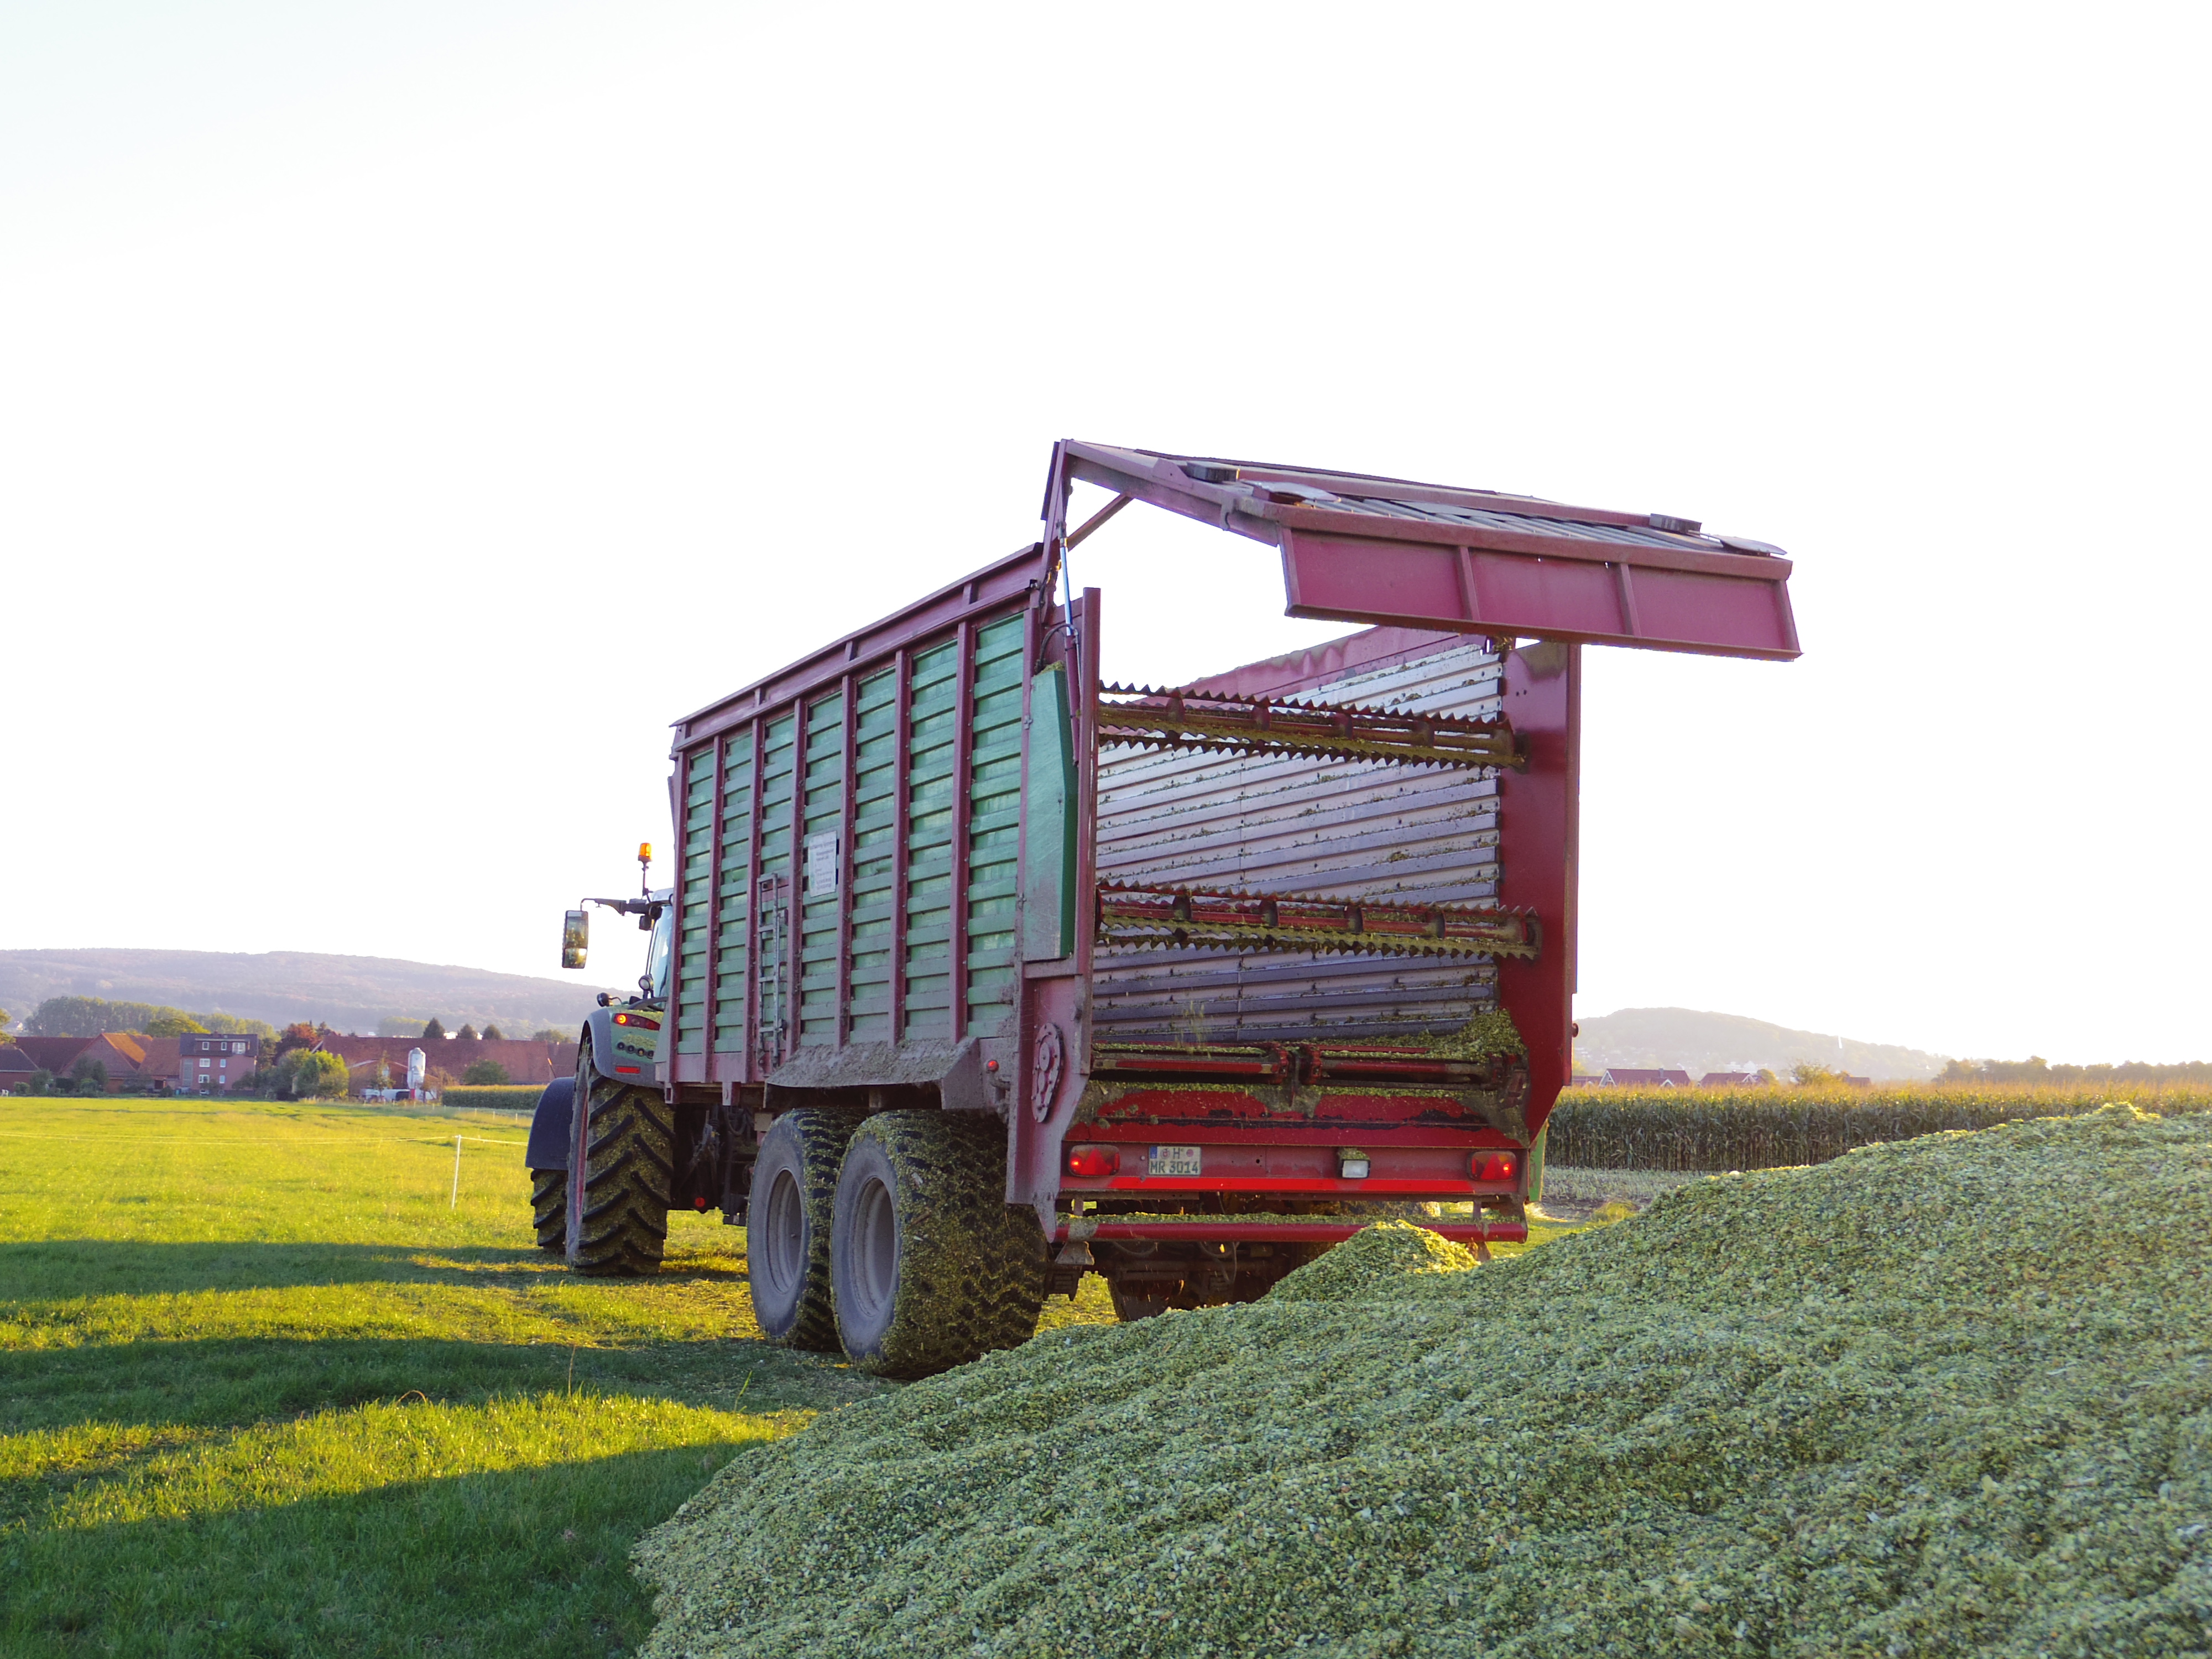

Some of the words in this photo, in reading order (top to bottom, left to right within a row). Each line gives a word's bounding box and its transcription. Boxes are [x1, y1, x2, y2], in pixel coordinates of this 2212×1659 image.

[1173, 1147, 1180, 1160] H
[1150, 1161, 1166, 1173] MR
[1170, 1161, 1198, 1173] 3014
